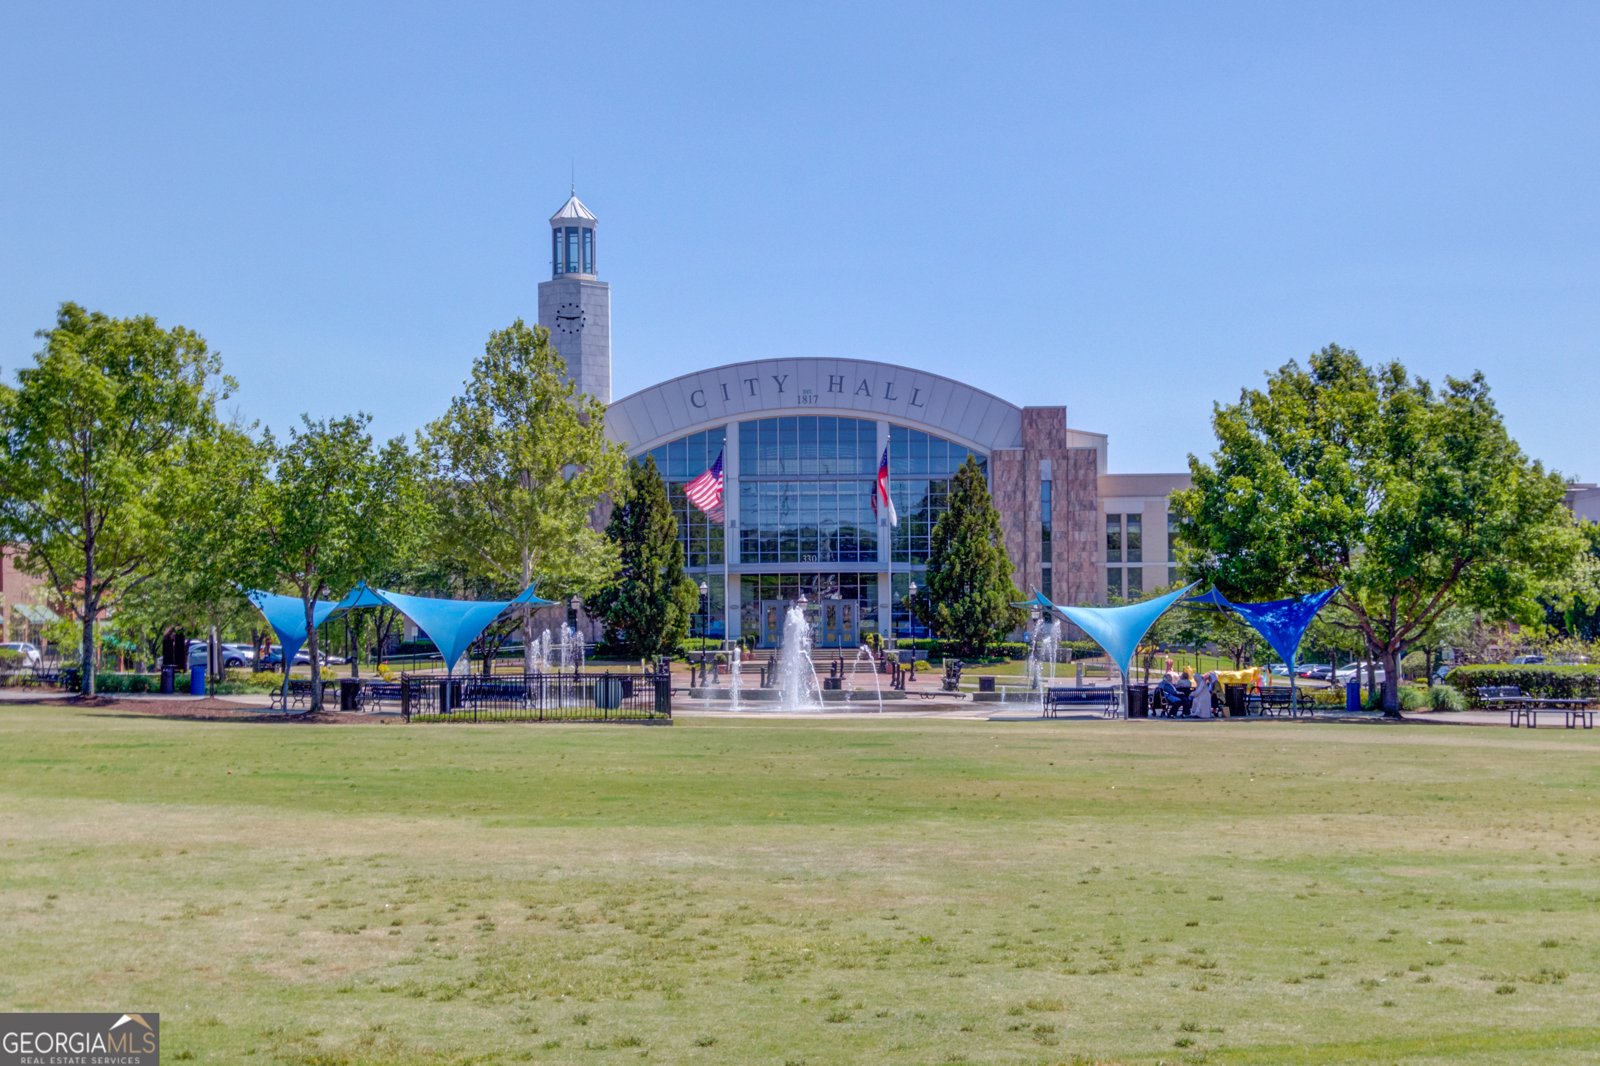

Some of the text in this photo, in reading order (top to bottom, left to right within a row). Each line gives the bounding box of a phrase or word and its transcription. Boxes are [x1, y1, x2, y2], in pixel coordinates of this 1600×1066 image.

[691, 375, 925, 409] CITY HALL
[798, 395, 819, 405] 1817
